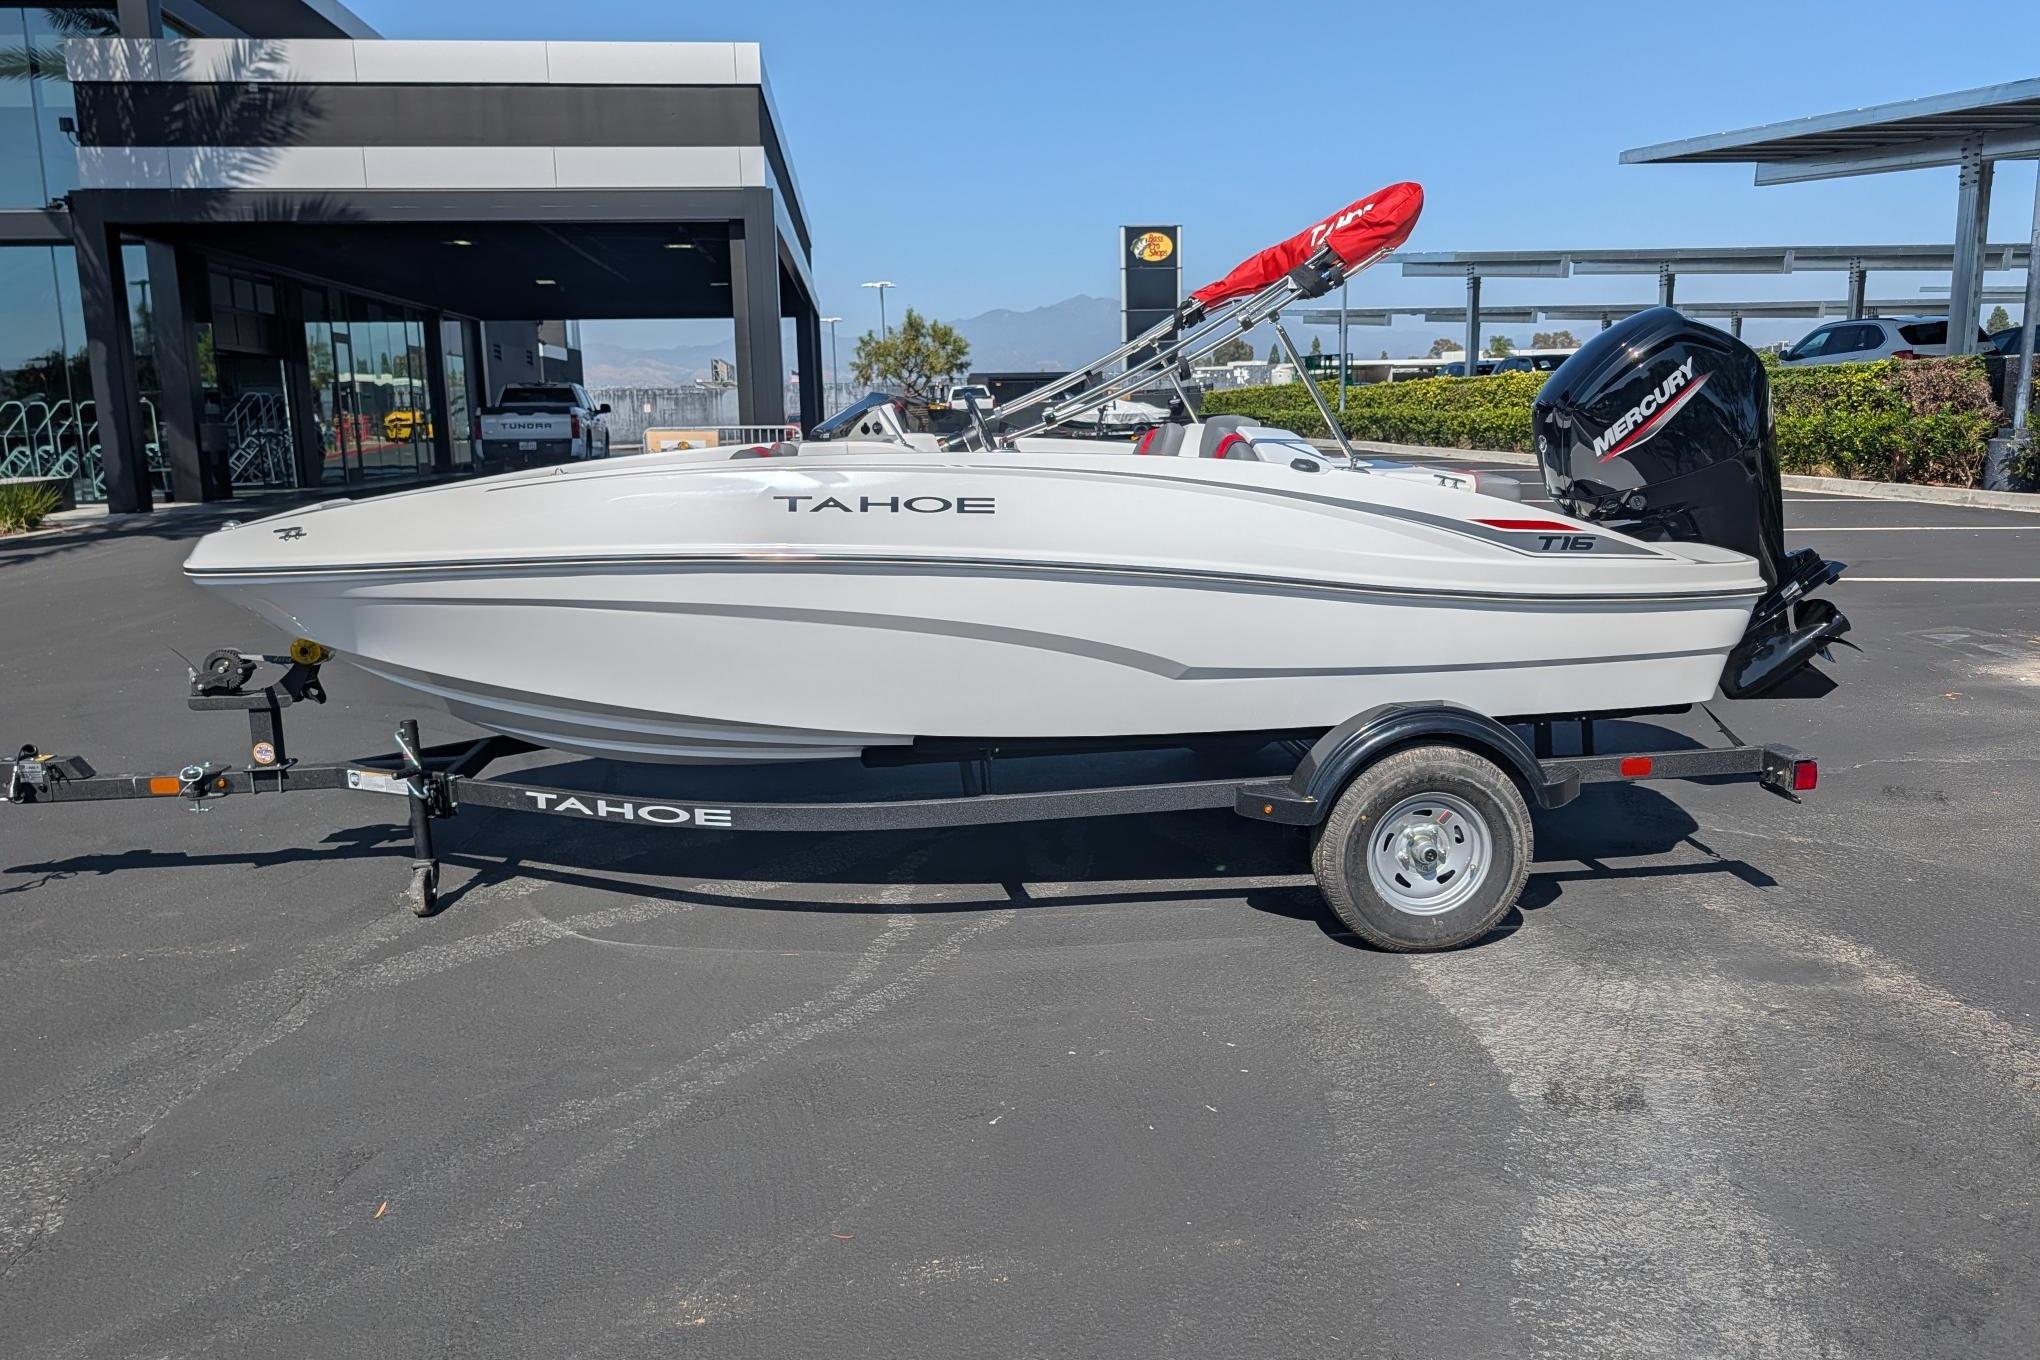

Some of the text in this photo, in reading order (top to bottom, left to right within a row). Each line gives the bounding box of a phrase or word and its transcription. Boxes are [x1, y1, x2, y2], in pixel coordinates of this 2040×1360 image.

[1149, 234, 1164, 242] Bass
[1149, 241, 1161, 250] Pro
[1149, 249, 1168, 258] Shops
[1593, 356, 1693, 456] MERCURY
[773, 496, 995, 514] TAHOE
[1538, 535, 1597, 551] T16
[525, 791, 732, 827] TAHOE
